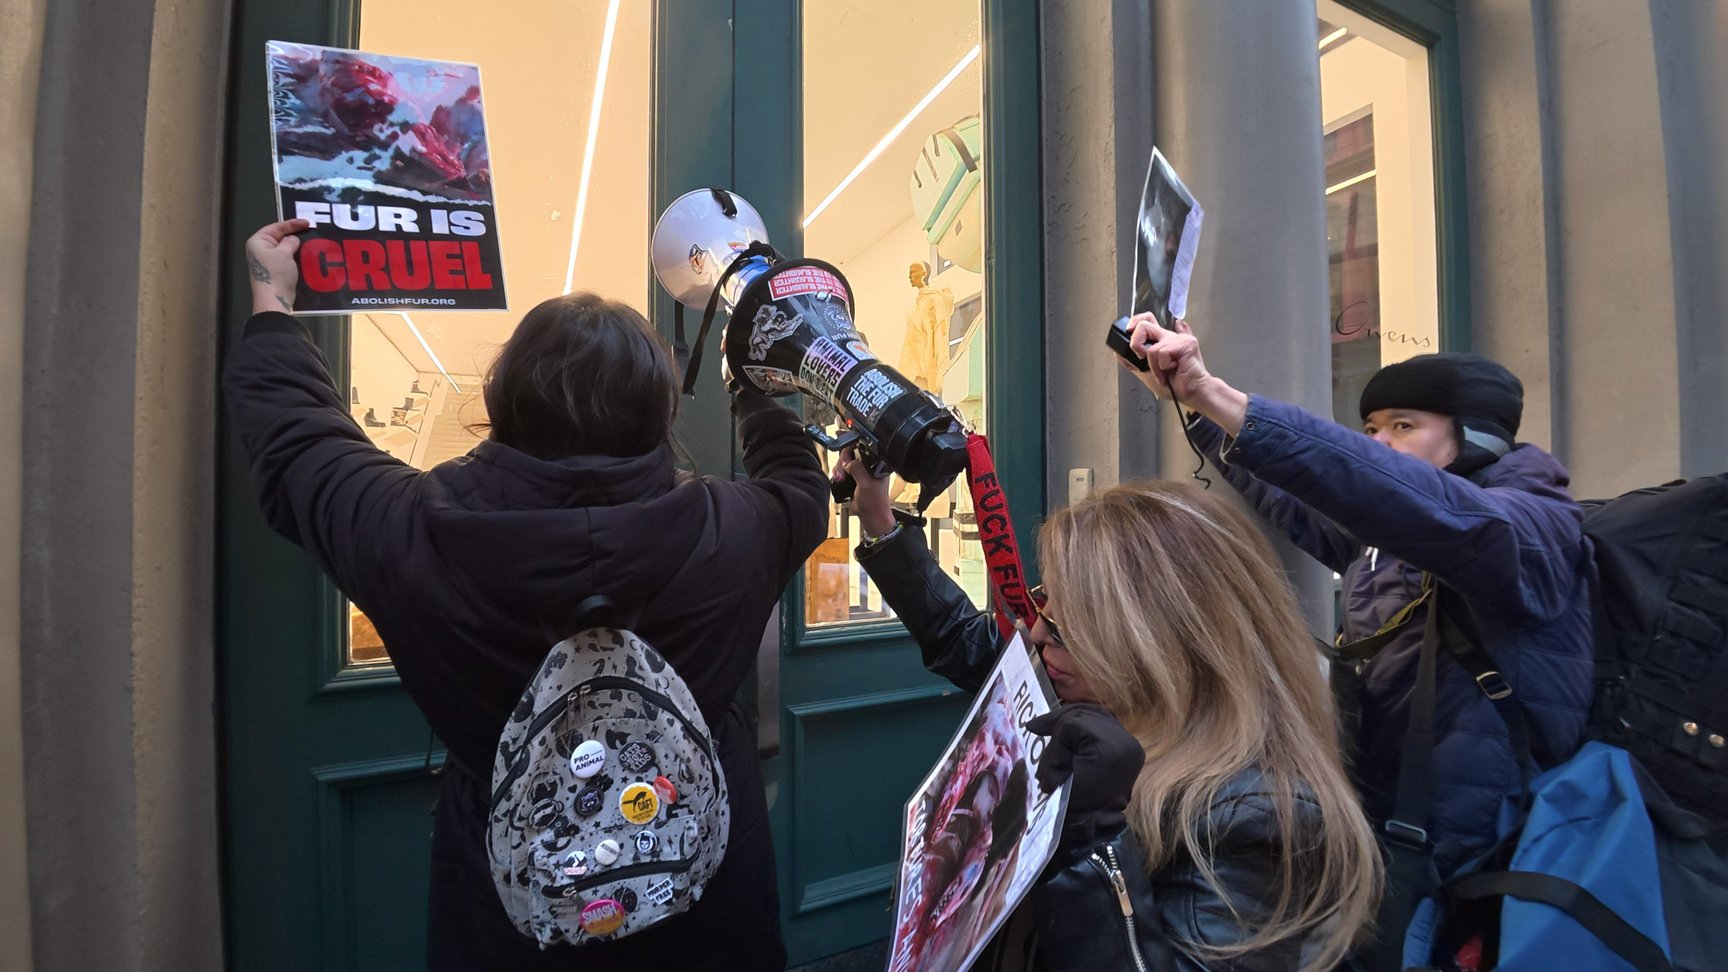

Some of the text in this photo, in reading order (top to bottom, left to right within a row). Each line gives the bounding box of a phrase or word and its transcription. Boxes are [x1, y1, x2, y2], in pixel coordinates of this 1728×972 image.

[295, 201, 487, 237] FUR IS
[300, 238, 493, 293] CRUEL
[351, 297, 457, 306] ABOLISHFUR.ORG
[1335, 300, 1431, 348] Owens
[804, 354, 842, 387] LOVERS
[813, 338, 852, 373] ANIMAL
[854, 375, 875, 397] THE
[868, 385, 889, 409] FUR
[864, 368, 904, 399] ABOLISH
[846, 386, 873, 418] TRADE
[974, 472, 1030, 618] FUCK FUR
[573, 753, 590, 764] PRO
[575, 755, 604, 771] ANIMAL
[582, 903, 617, 924] SMASH
